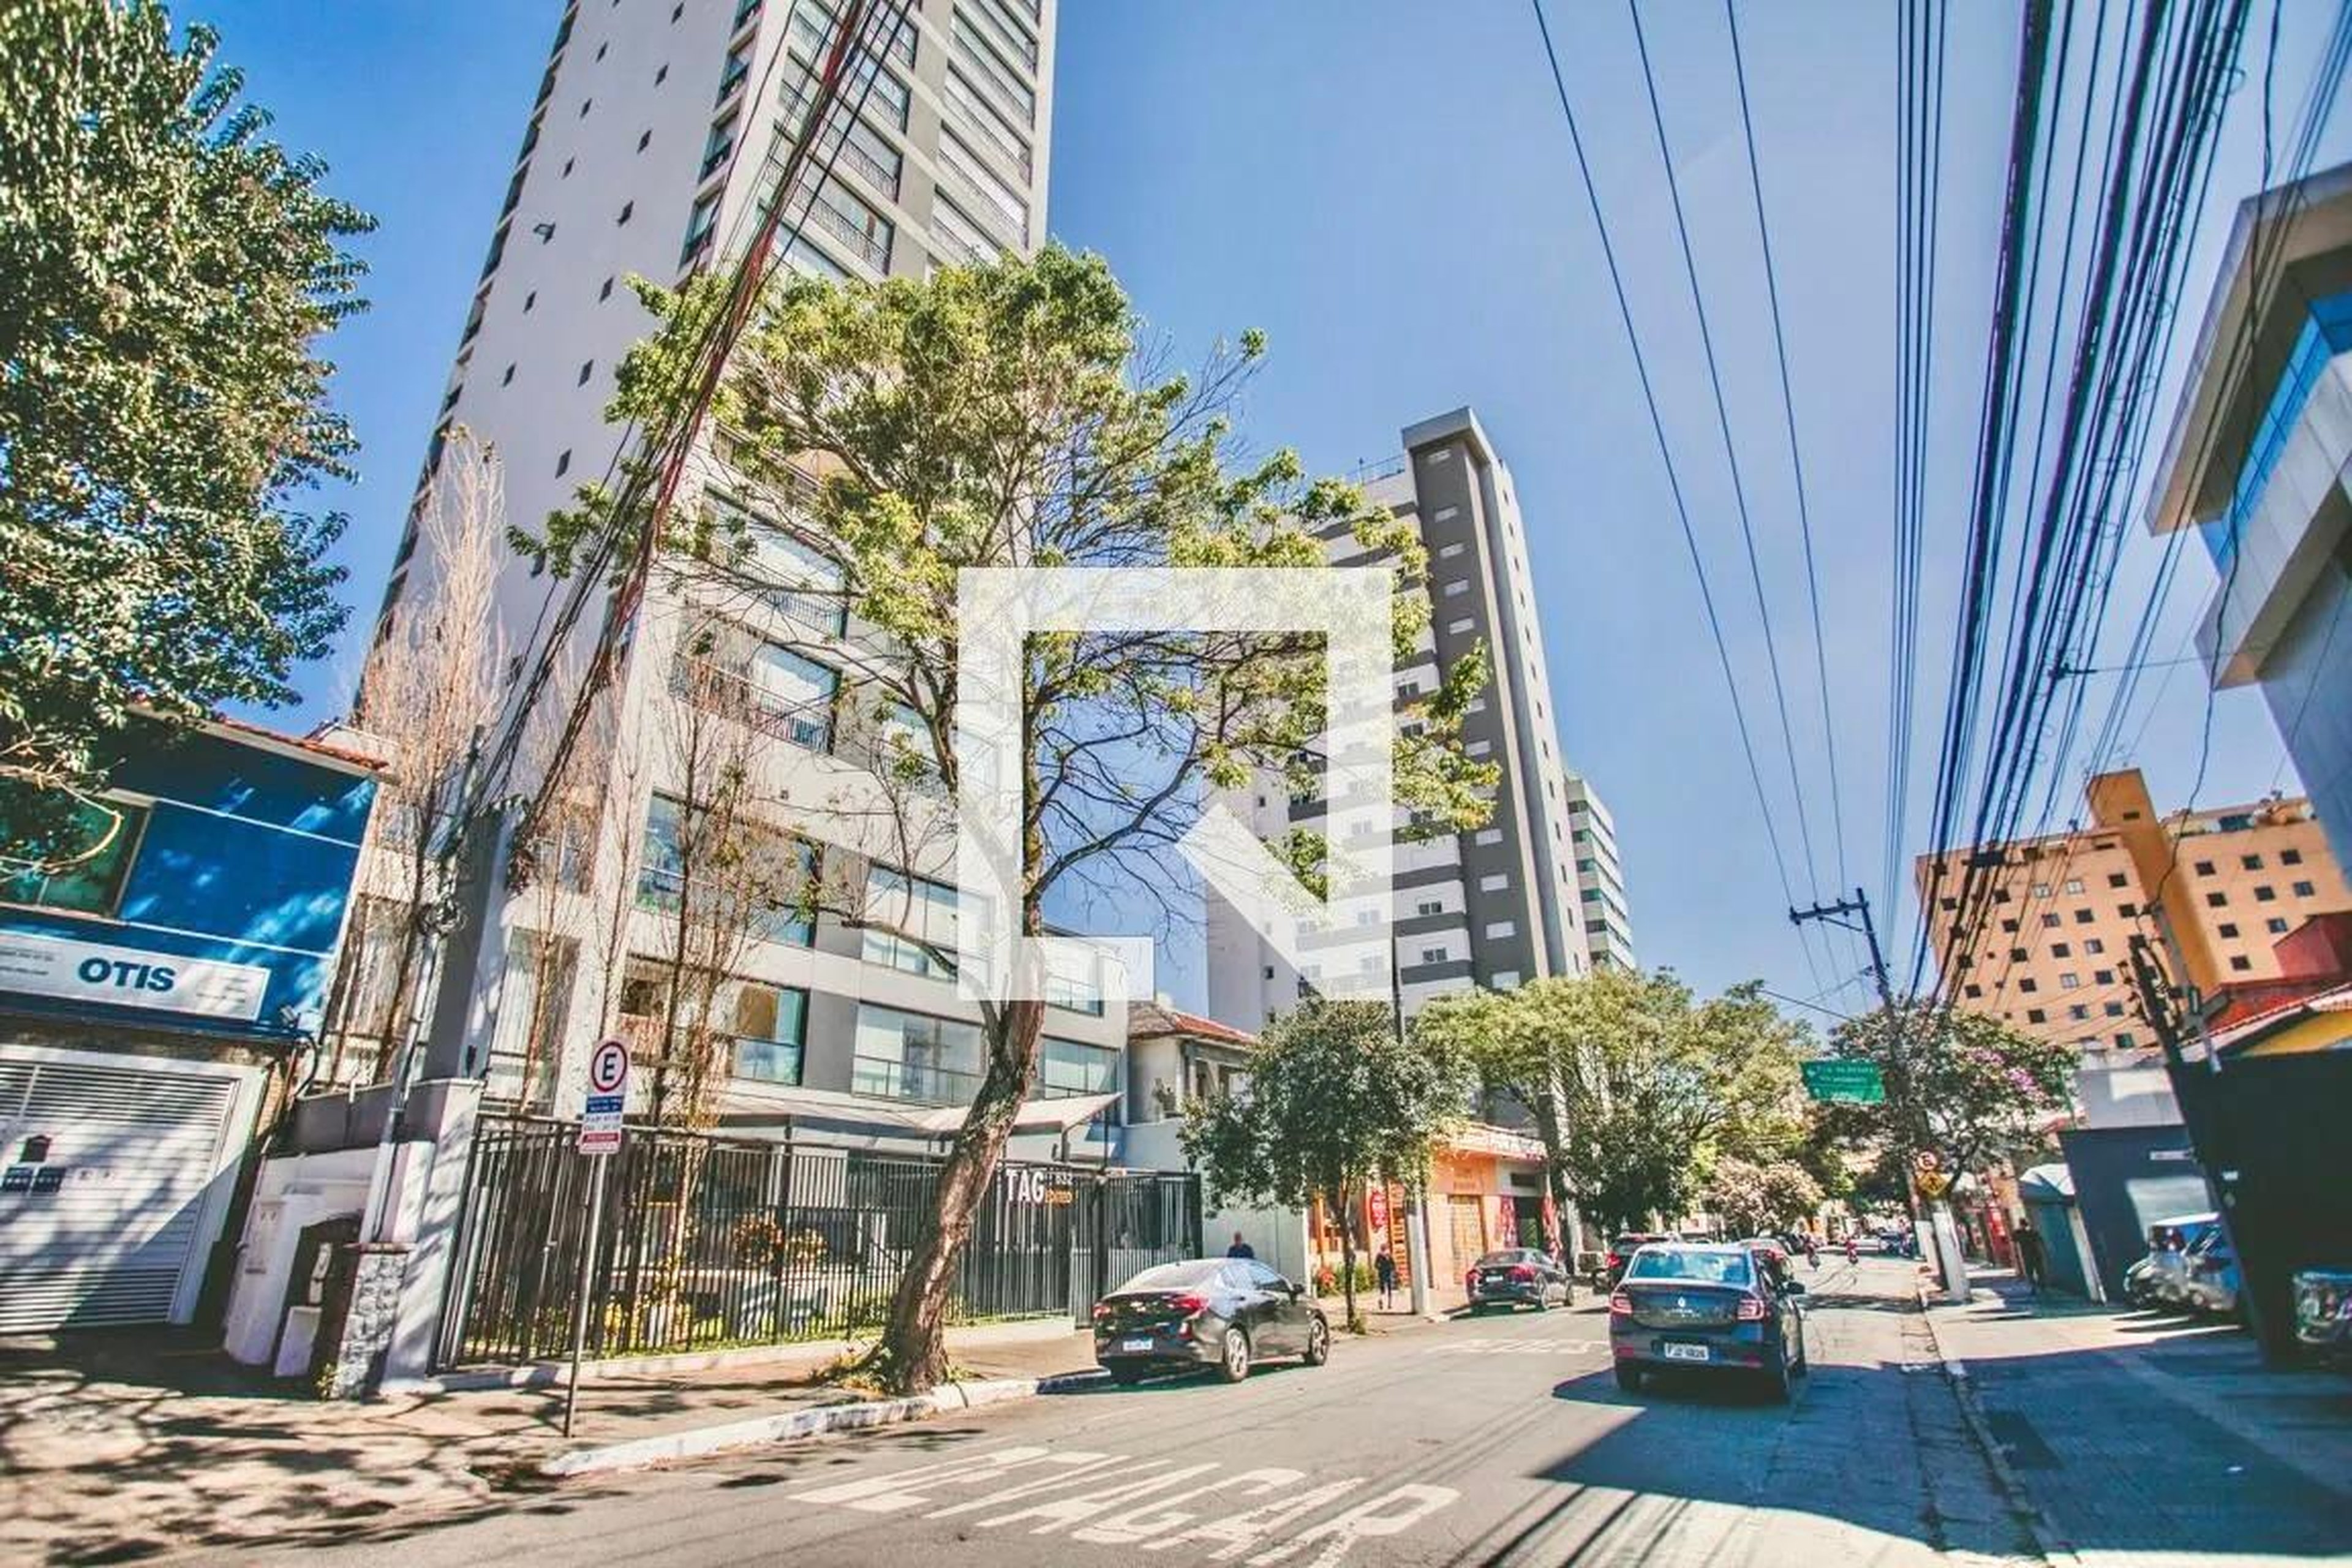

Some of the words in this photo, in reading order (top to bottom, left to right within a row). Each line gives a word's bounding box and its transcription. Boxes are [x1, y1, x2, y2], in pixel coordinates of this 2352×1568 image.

[78, 957, 176, 992] OTIS
[602, 1054, 617, 1081] E
[1006, 1168, 1044, 1204] TAG
